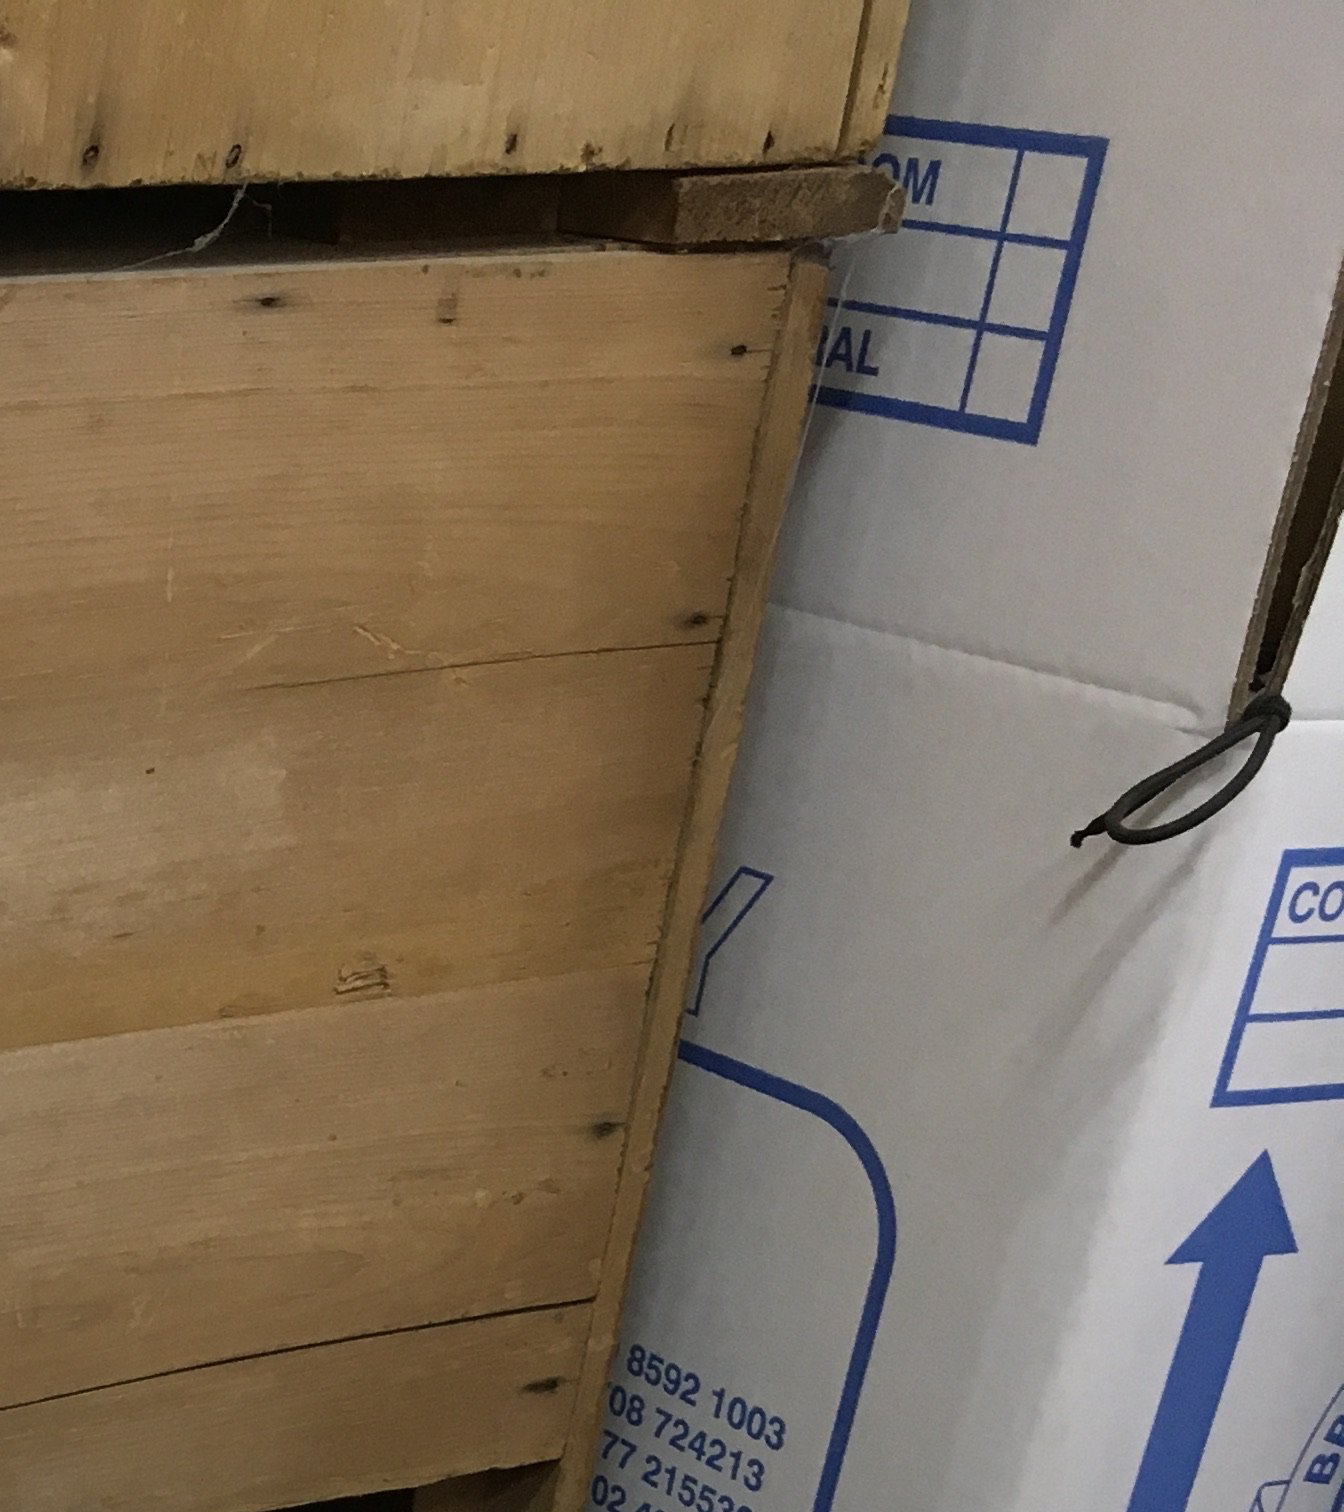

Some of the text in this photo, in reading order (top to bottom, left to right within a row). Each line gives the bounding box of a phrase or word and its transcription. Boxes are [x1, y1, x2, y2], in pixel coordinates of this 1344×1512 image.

[626, 1344, 786, 1451] 8592 1003
[601, 1429, 637, 1469] 77
[654, 1407, 765, 1492] 724213
